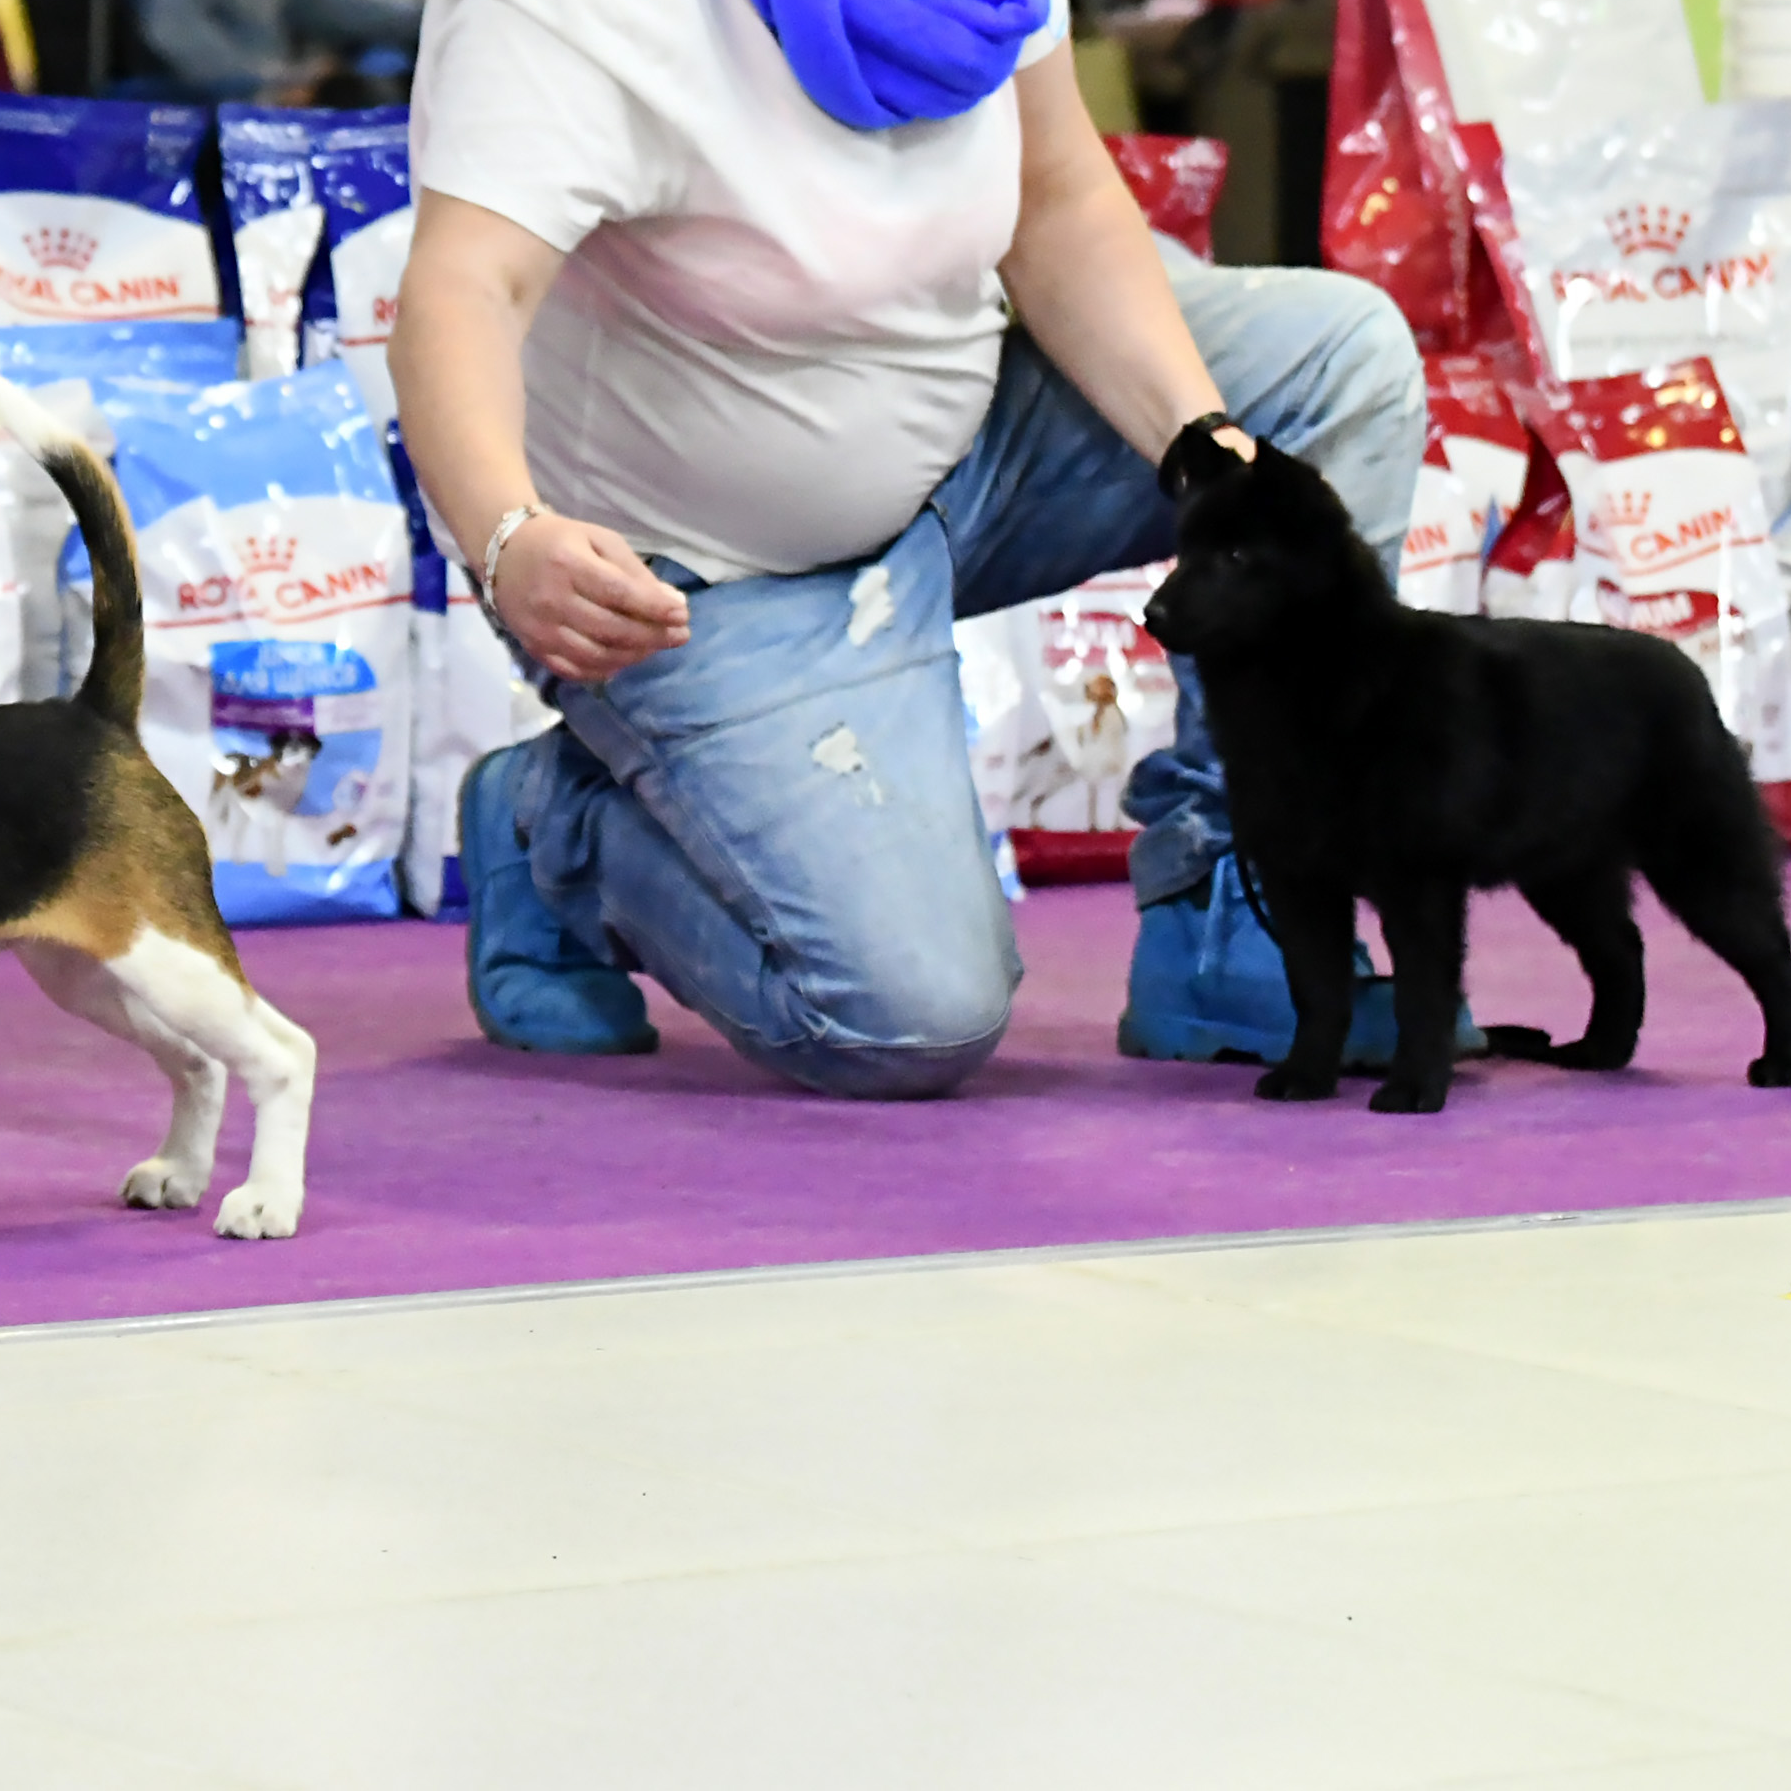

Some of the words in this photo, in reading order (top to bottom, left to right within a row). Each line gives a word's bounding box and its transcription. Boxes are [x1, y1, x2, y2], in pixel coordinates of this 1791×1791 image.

[69, 275, 182, 306] CANIN
[1630, 507, 1735, 560] CANIN
[275, 561, 387, 609] CANIN
